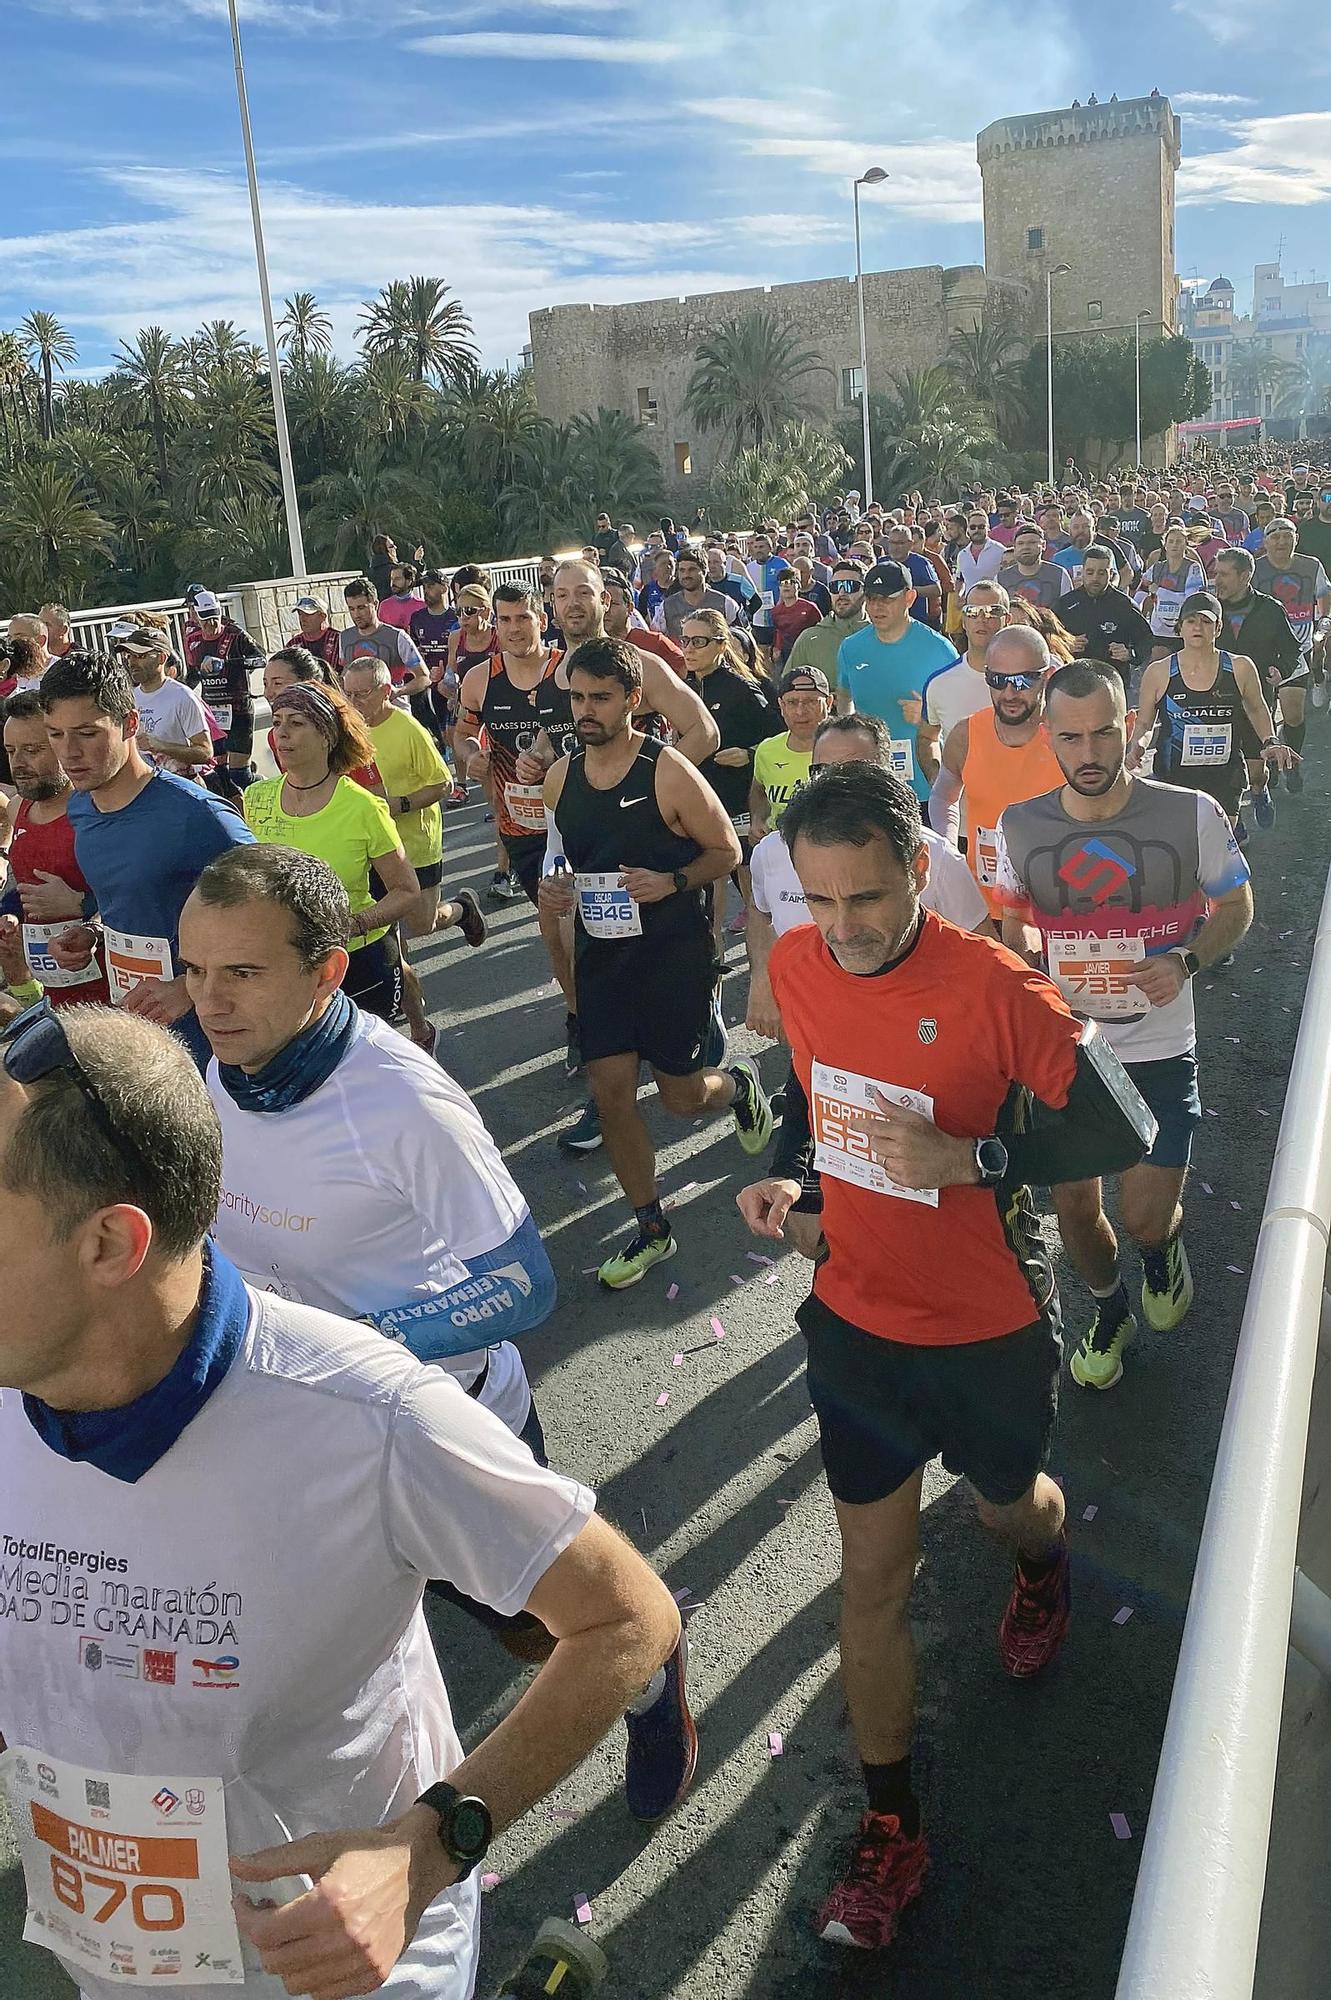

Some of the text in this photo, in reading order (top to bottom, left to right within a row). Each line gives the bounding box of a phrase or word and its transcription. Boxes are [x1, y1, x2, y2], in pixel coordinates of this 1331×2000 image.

[490, 721, 519, 731] CLASES
[520, 721, 531, 730] DE
[1173, 709, 1233, 719] ROJALES
[1189, 745, 1225, 756] 1588
[582, 904, 633, 921] 2346
[1107, 921, 1179, 940] ELCHE
[29, 955, 58, 971] 26
[1083, 962, 1111, 974] JAVIER
[821, 1117, 879, 1163] 52
[450, 1289, 515, 1327] ALPRO
[2, 1535, 129, 1575] TotalEnergies
[0, 1559, 242, 1617] Media maratón
[50, 1600, 86, 1629] DE
[93, 1607, 240, 1645] GRANADA
[67, 1825, 142, 1873] PALMER
[49, 1853, 186, 1932] 870
